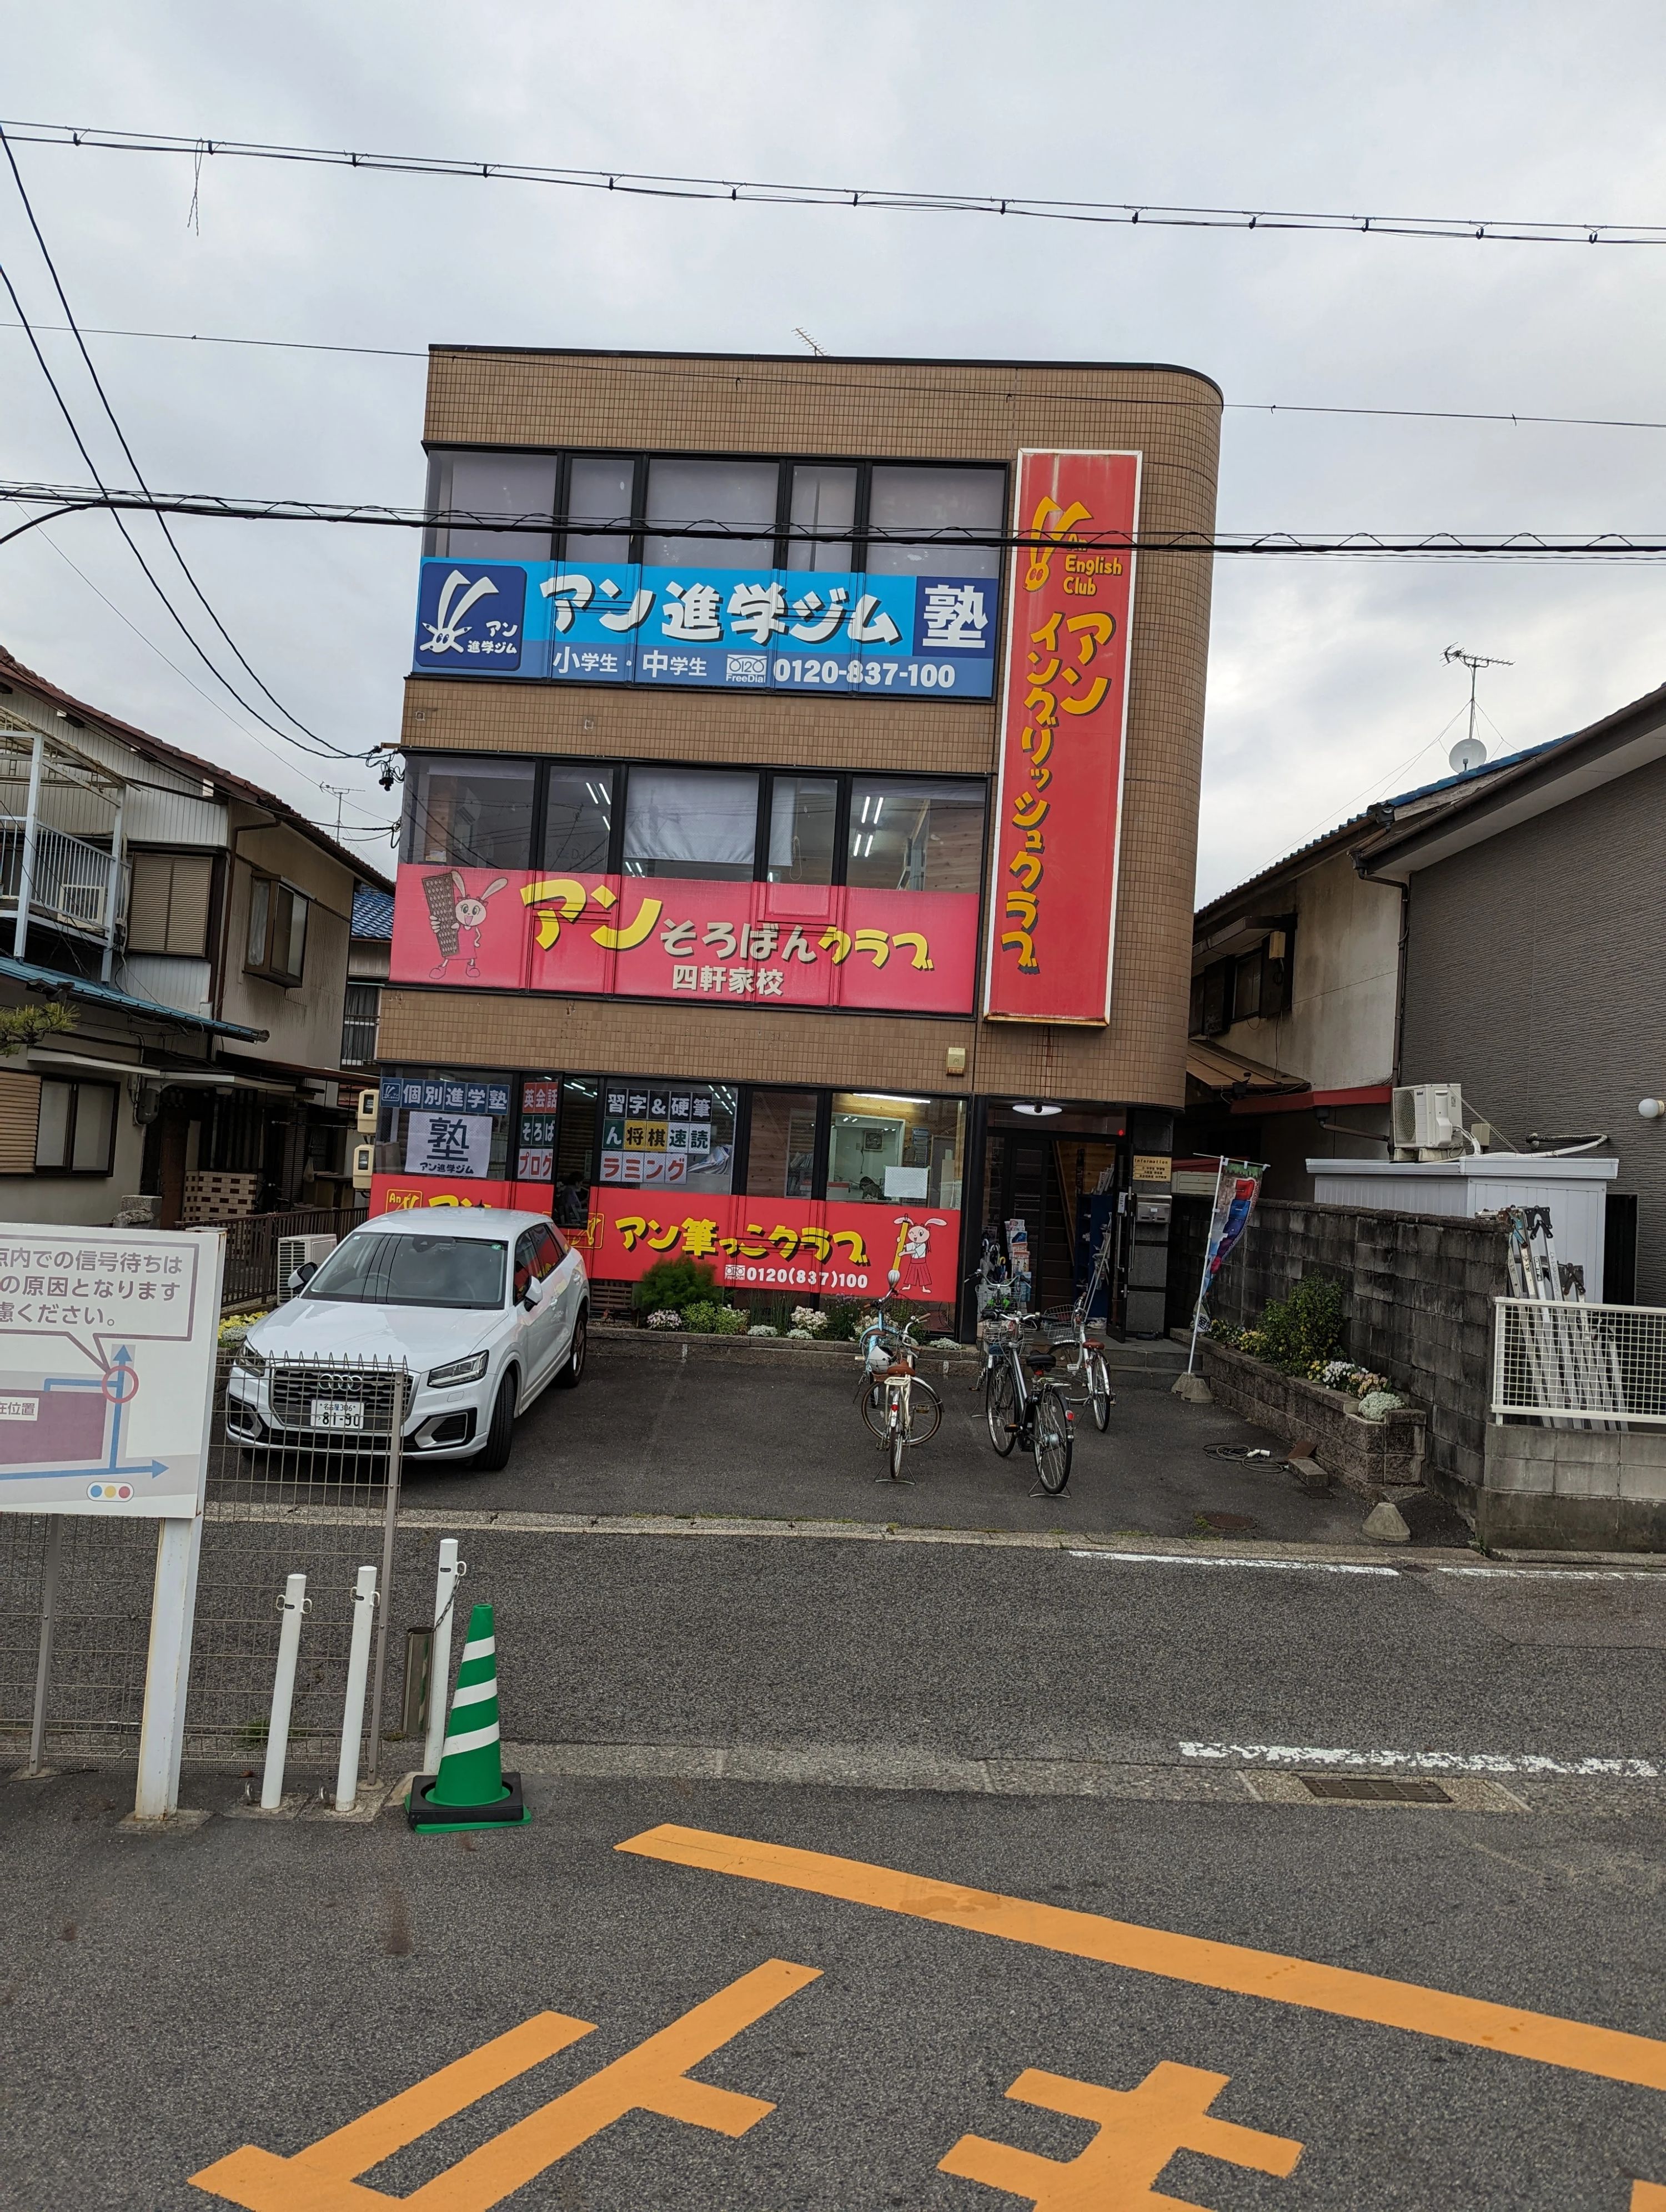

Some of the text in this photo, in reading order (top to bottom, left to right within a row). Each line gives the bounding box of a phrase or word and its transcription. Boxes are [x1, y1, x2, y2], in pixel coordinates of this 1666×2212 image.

[1065, 554, 1122, 575] English
[1063, 576, 1096, 596] Club
[540, 574, 987, 648] アン進学ジム 塾
[486, 621, 518, 637] アン
[468, 640, 517, 654] 進学ジム
[774, 658, 955, 688] 0120-837-100
[1060, 612, 1113, 715] アン
[726, 673, 766, 683] FreeDial
[1001, 612, 1064, 969] イングリッシュクラブ
[673, 965, 784, 996] 四軒家校
[404, 1084, 508, 1110] 個別進学塾
[524, 1089, 557, 1108] 英会話
[426, 1117, 470, 1162] 塾
[522, 1120, 555, 1142] そろば
[420, 1162, 474, 1174] アン進学ジム
[519, 1152, 685, 1182] プログ ラミング
[389, 1193, 401, 1203] An
[615, 1216, 868, 1266] アン筆っこクラブ
[1, 1276, 180, 1301] の原因となります
[747, 1267, 868, 1288] 0120(837)100
[323, 1412, 360, 1427] 81-90
